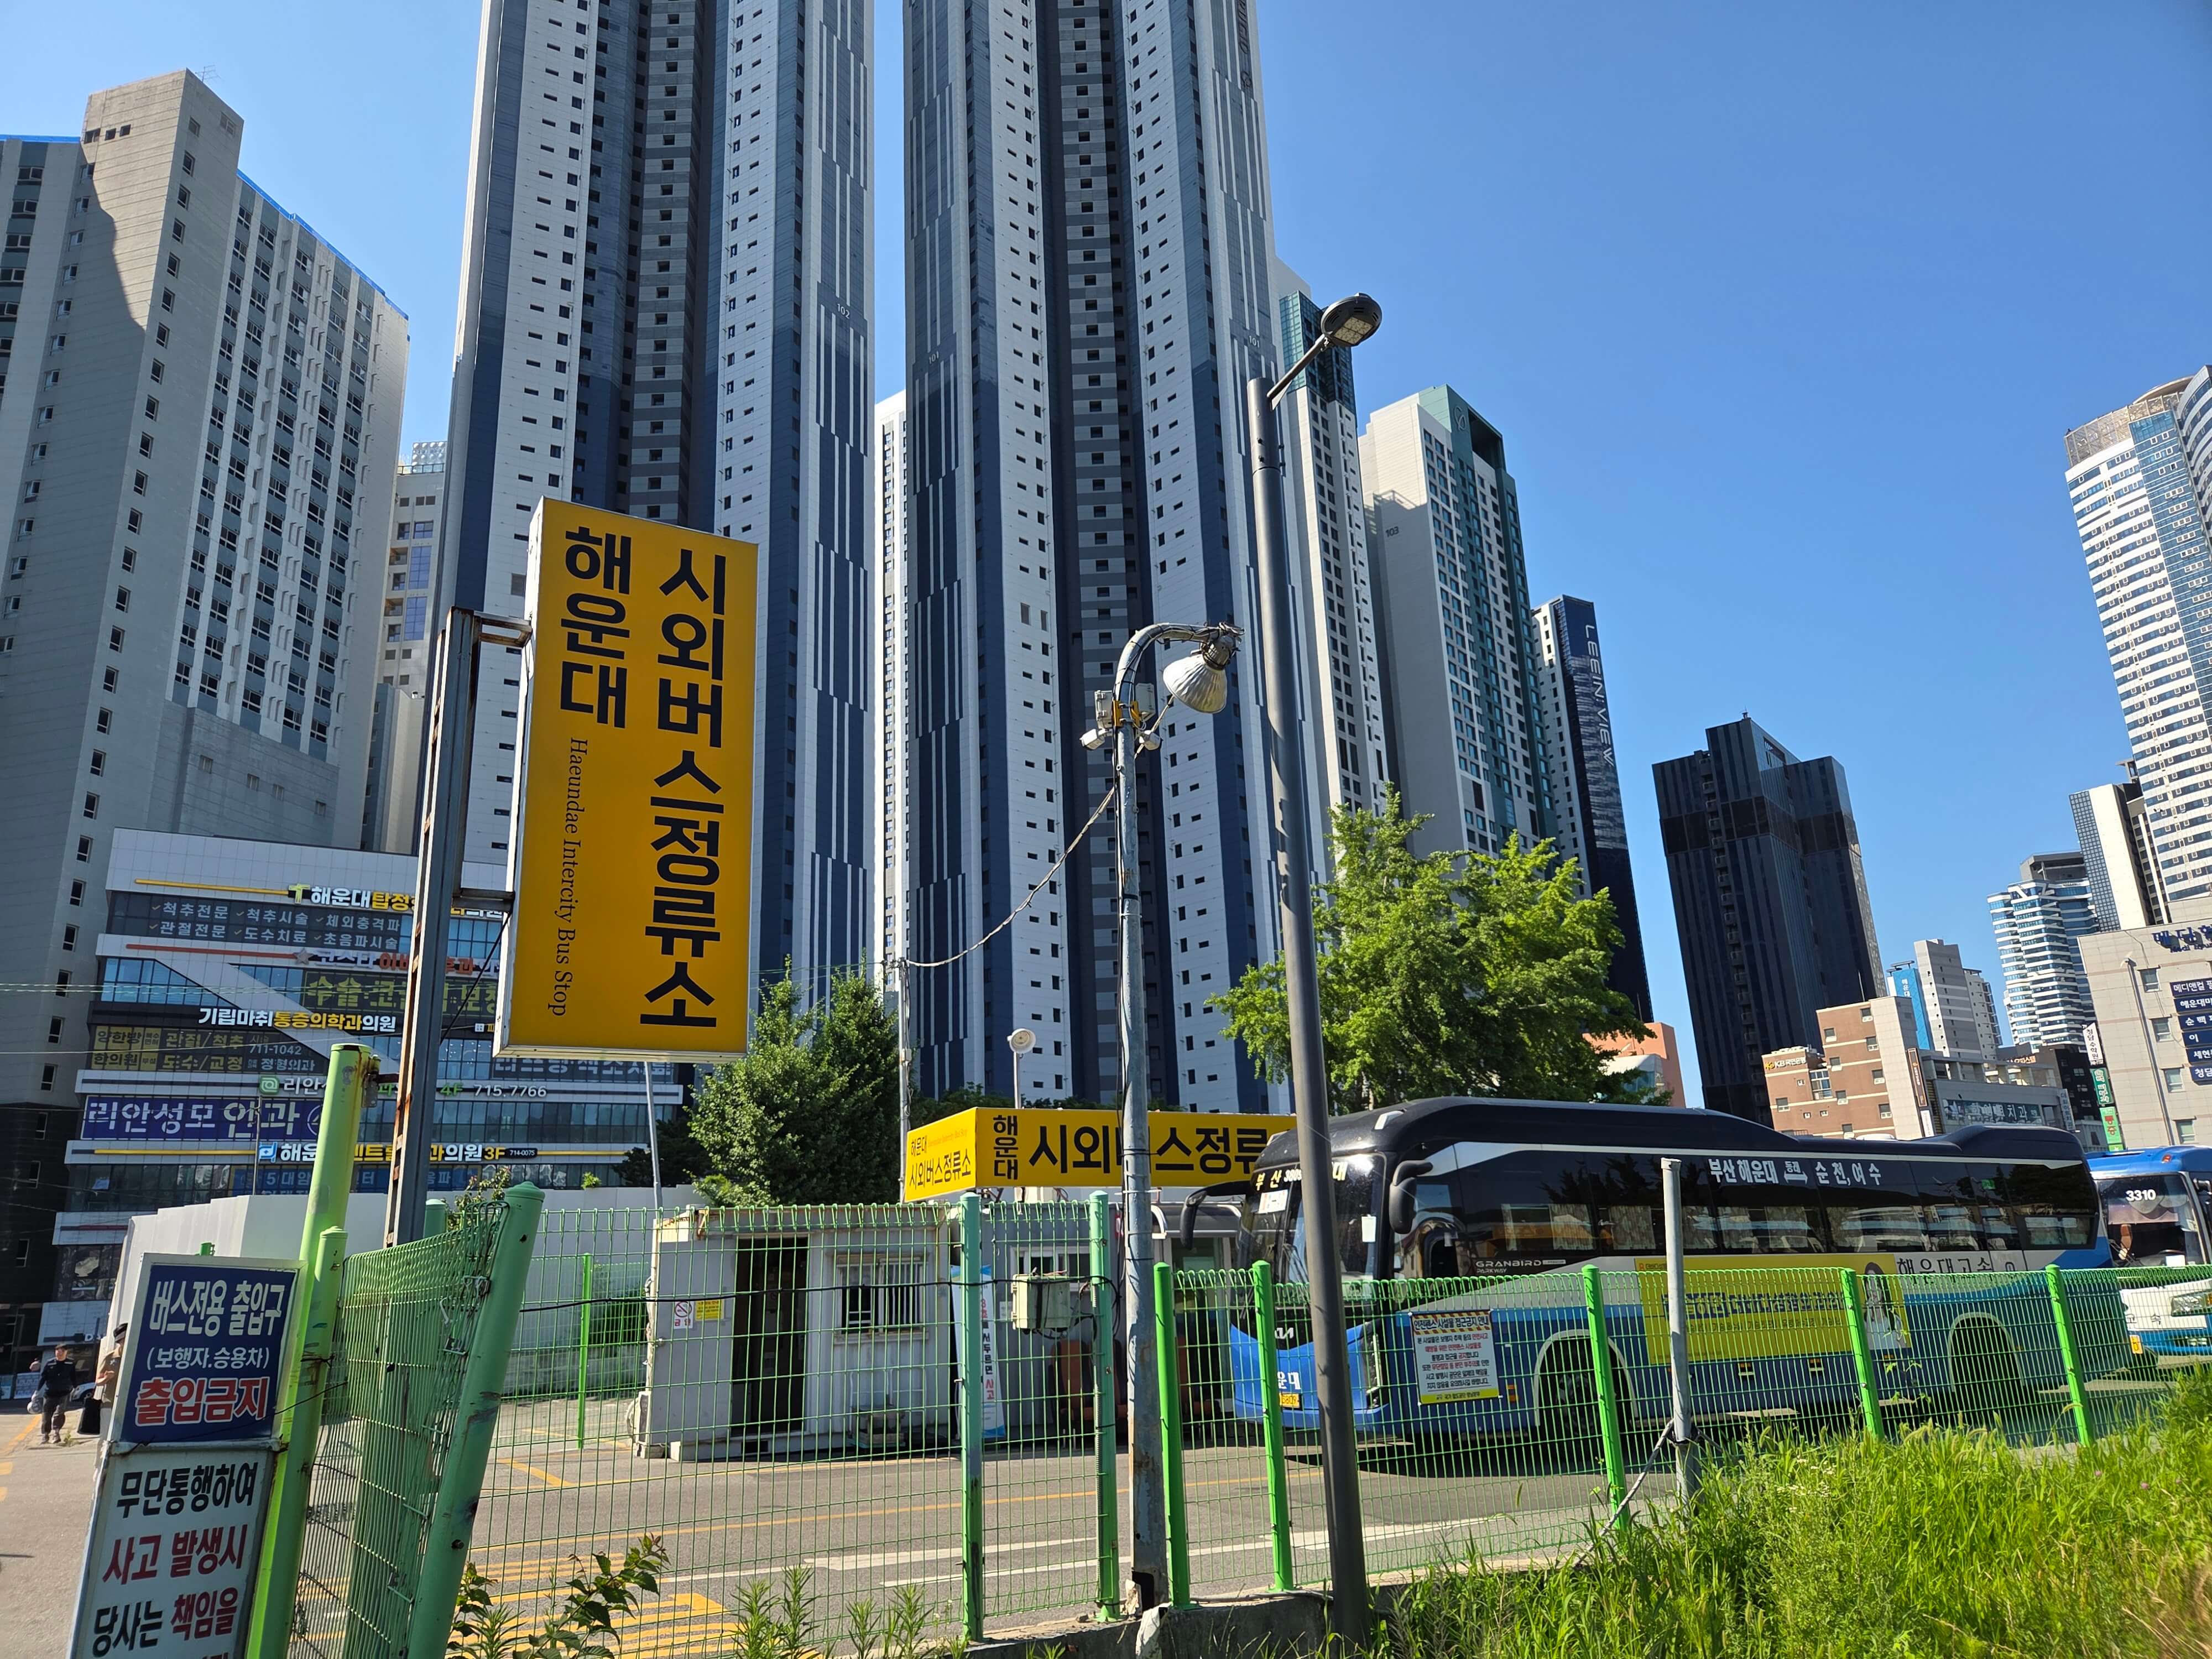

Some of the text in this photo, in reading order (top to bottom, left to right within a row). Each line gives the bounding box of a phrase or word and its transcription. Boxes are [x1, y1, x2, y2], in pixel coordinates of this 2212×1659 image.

[837, 304, 850, 319] 102
[1249, 336, 1259, 348] 101
[929, 351, 939, 364] 101
[1385, 526, 1399, 538] 103
[560, 526, 632, 729] 해운대
[1597, 708, 1614, 766] VIEW
[640, 549, 726, 1027] 시외버스정류소
[547, 737, 588, 1016] Haeundae Intercity Bus Stop
[311, 886, 415, 912] 해운대탑정
[163, 902, 400, 932] 척추전문 척추시술 체외충격파
[160, 921, 398, 950] 관절전문 도수치료 초음파시술
[199, 1008, 396, 1032] 기립마취통증의학과의원
[249, 1044, 302, 1055] 711-1042
[2189, 1034, 2199, 1043] 이
[261, 1058, 315, 1071] 정형외과
[283, 1077, 327, 1095] 리안
[440, 1082, 547, 1098] 4F 715.7766
[88, 1101, 300, 1138] 리안성모 안과
[484, 1146, 505, 1160] 3F
[911, 1135, 927, 1157] 해운대
[993, 1114, 1019, 1180] 해운대
[1029, 1125, 1267, 1174] 시외스정류
[909, 1149, 971, 1190] 시외버스정류소
[1256, 1169, 1283, 1191] 부산
[1708, 1159, 1738, 1183] 부산
[1736, 1159, 1779, 1183] 해운대
[2126, 1189, 2156, 1202] 3310
[1475, 1259, 1542, 1267] GRANBIRD
[149, 1280, 285, 1337] 버스전용 출입구
[146, 1347, 270, 1371] (보행자.승용차)
[983, 1333, 994, 1375] 서두르면
[985, 1379, 995, 1400] 사고
[1277, 1371, 1301, 1390] 운대
[135, 1376, 270, 1427] 출입금지
[117, 1462, 258, 1519] 무단통행하여
[102, 1524, 248, 1585] 사고 발생시
[92, 1587, 238, 1658] 당사는 책임을
